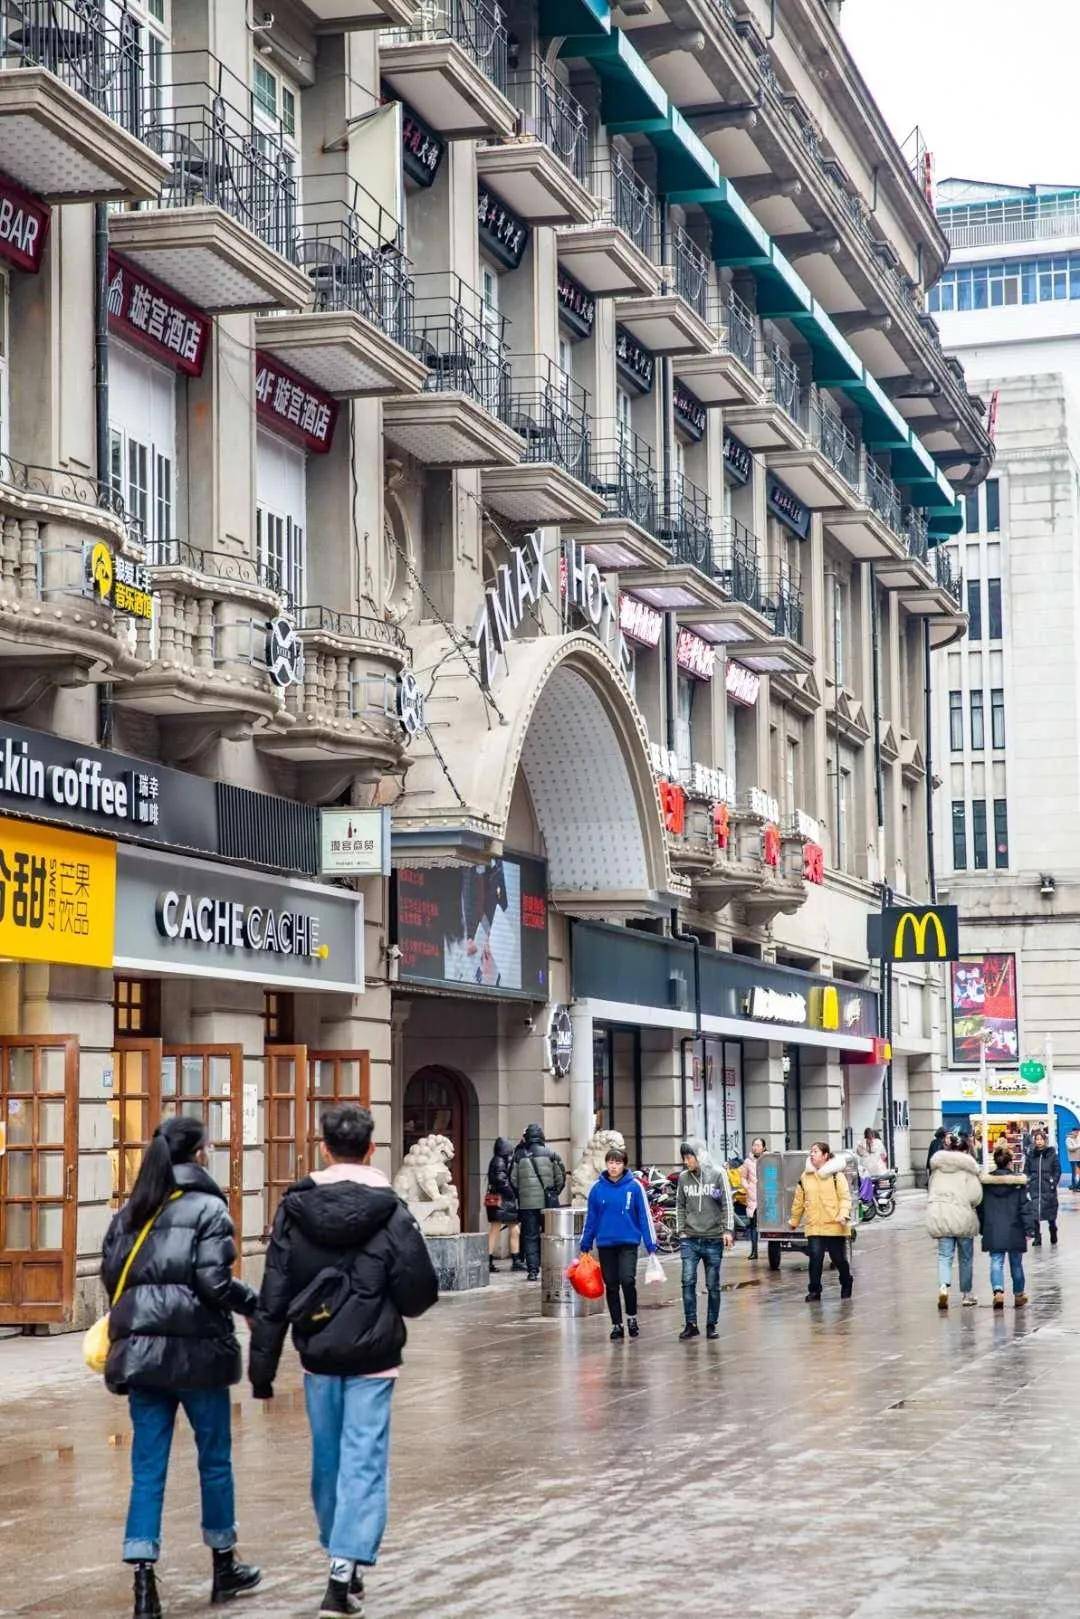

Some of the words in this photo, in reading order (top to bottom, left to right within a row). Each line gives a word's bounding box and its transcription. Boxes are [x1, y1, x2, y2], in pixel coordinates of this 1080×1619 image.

[0, 199, 38, 256] BAR
[128, 285, 201, 362] 璇宫酒店
[255, 368, 275, 403] 4F
[274, 377, 331, 441] 璇宫酒店
[0, 738, 44, 798] kin
[50, 757, 128, 817] coffee
[139, 774, 159, 798] 瑞幸
[139, 801, 159, 825] 咖啡
[160, 891, 244, 947] CACHE
[247, 906, 320, 957] CACHE
